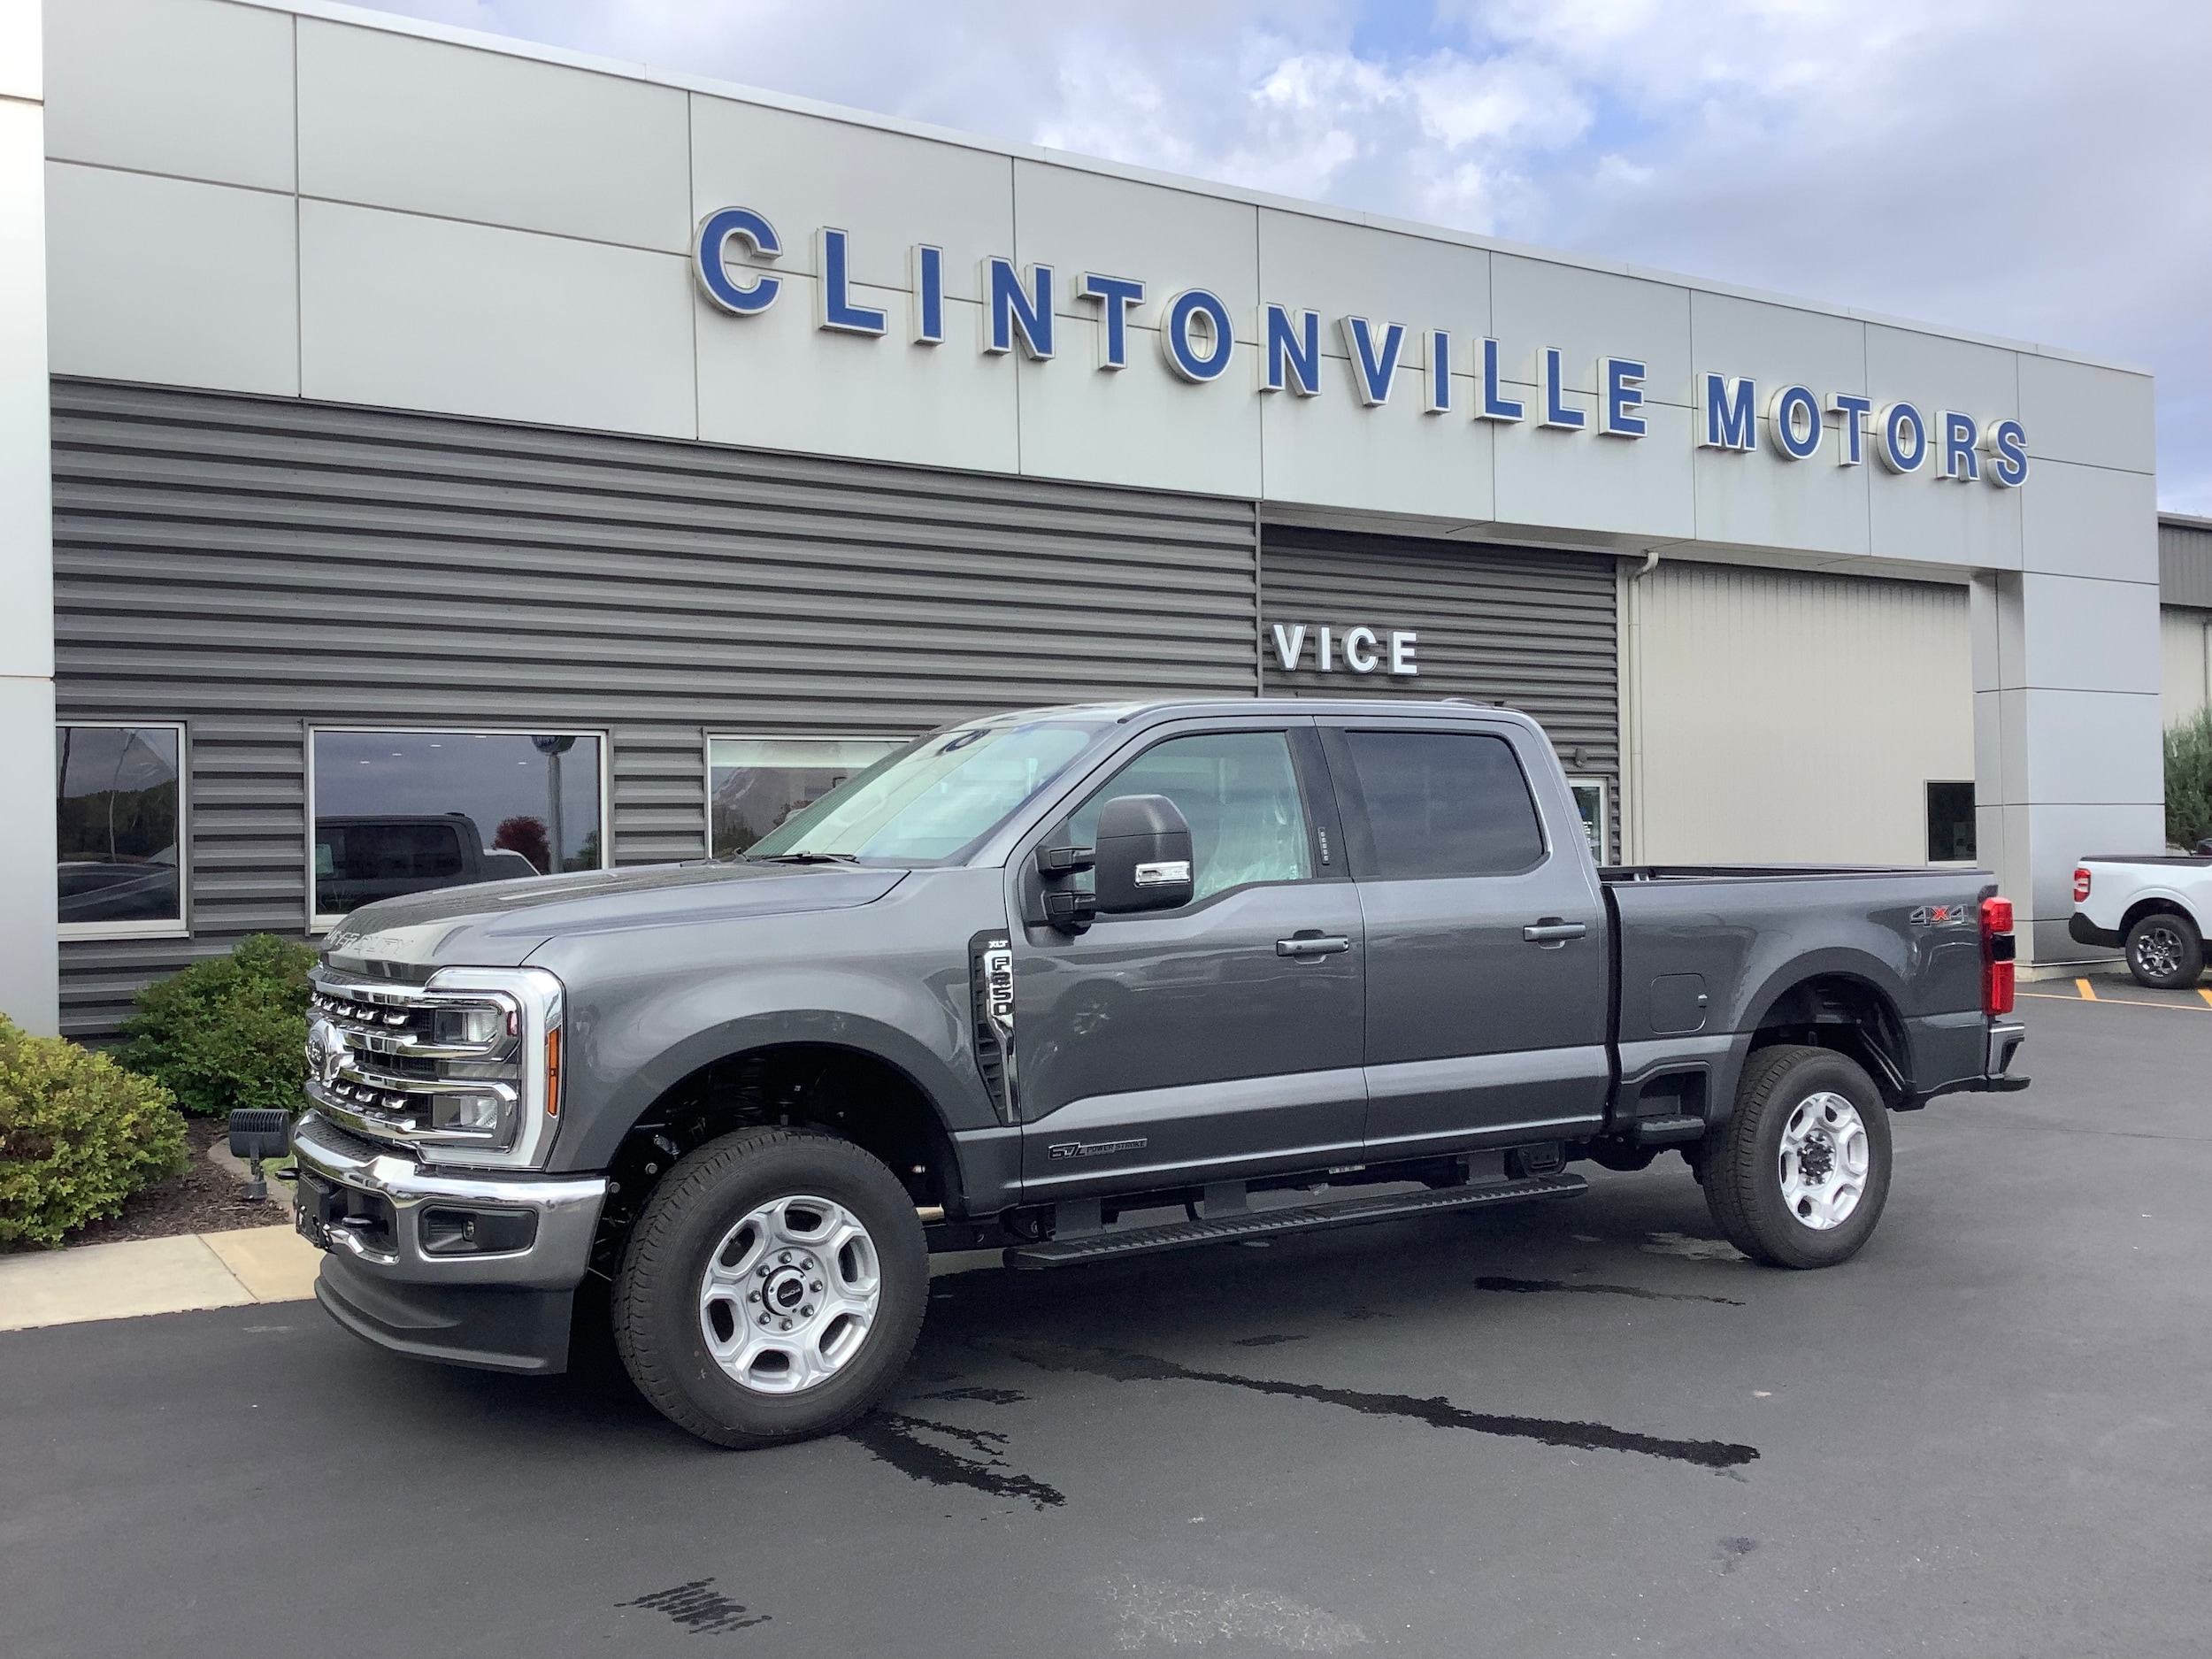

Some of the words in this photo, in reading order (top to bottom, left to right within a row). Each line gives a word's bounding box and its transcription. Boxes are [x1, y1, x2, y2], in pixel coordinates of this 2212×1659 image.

[693, 206, 1648, 438] CLINTONVILLE
[1697, 372, 2029, 488] MOTORS
[1272, 624, 1419, 676] VICE
[988, 940, 1009, 949] XLT
[1087, 1145, 1114, 1154] POWER
[1115, 1141, 1146, 1150] STROKE
